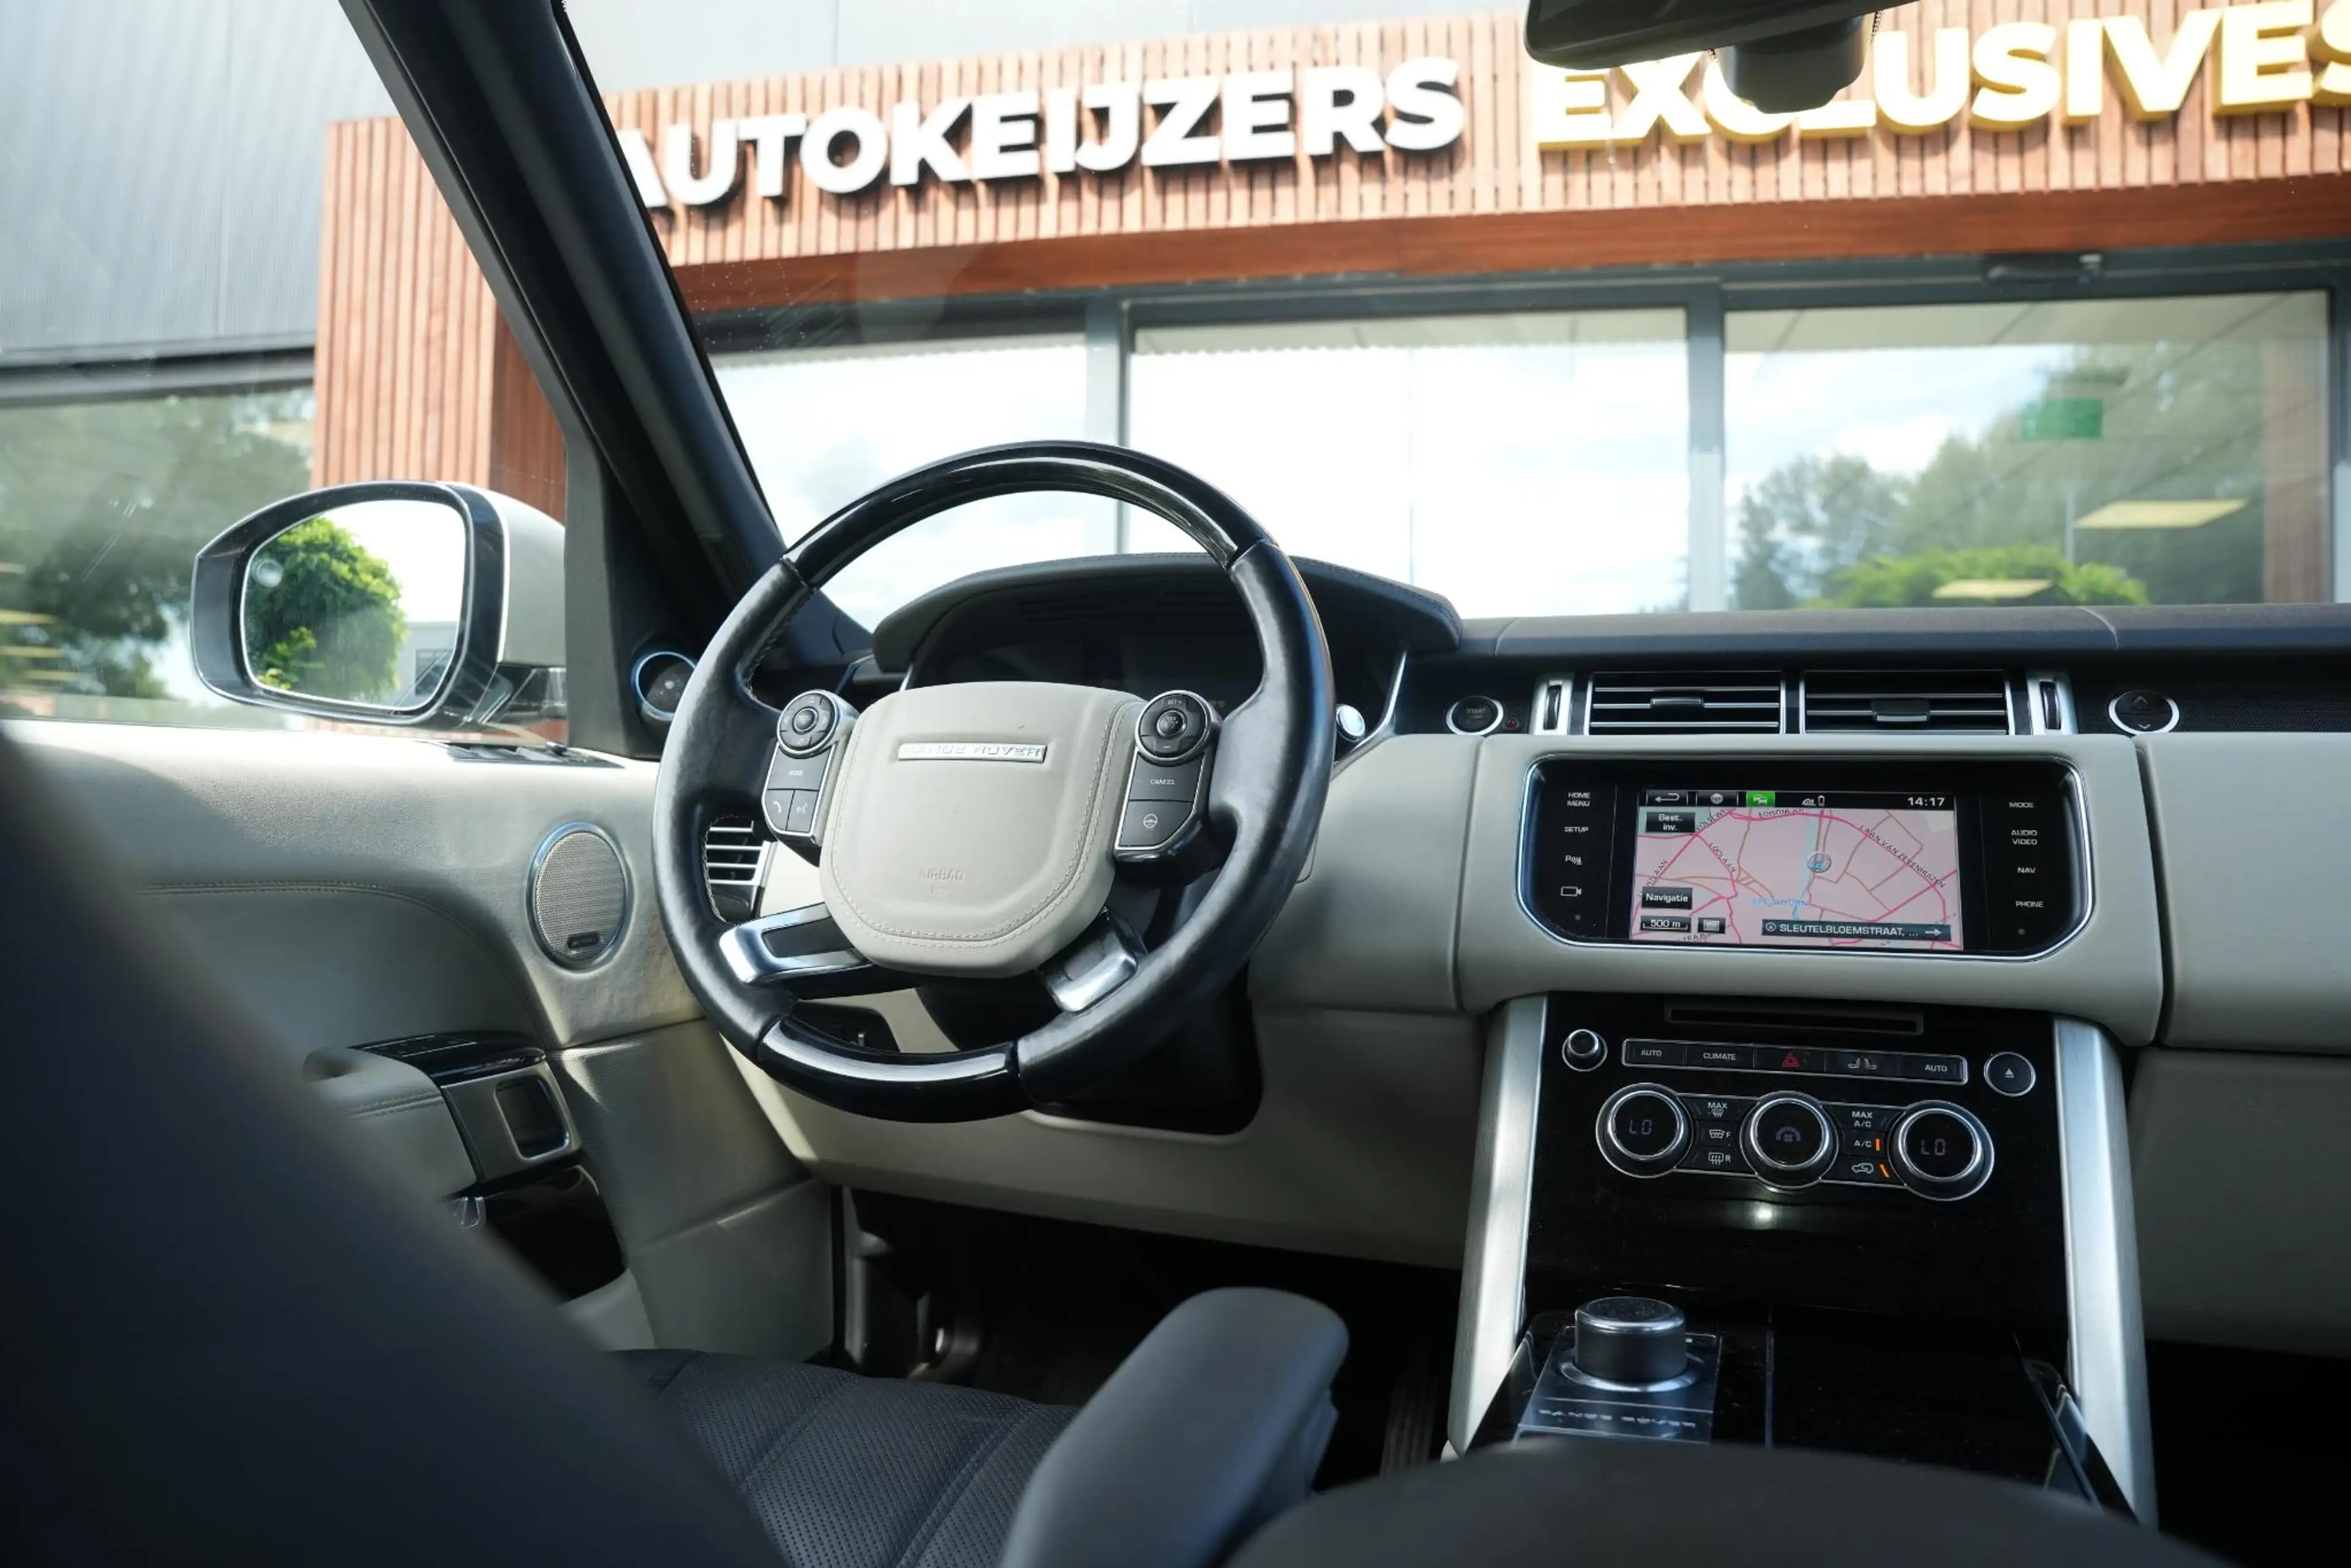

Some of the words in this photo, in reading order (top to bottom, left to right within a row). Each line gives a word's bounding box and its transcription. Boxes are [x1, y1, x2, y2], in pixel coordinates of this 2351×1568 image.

[617, 56, 1464, 207] AUTOKEIJZERS
[973, 745, 1041, 757] ROVER
[1907, 797, 1945, 806] 14:17
[1658, 814, 1683, 822] Best.
[1882, 839, 1899, 855] VAN
[1646, 893, 1689, 903] Navigatie
[1651, 919, 1670, 928] 500
[1780, 923, 1905, 937] SLEUTELBLOEMSTRAAT,
